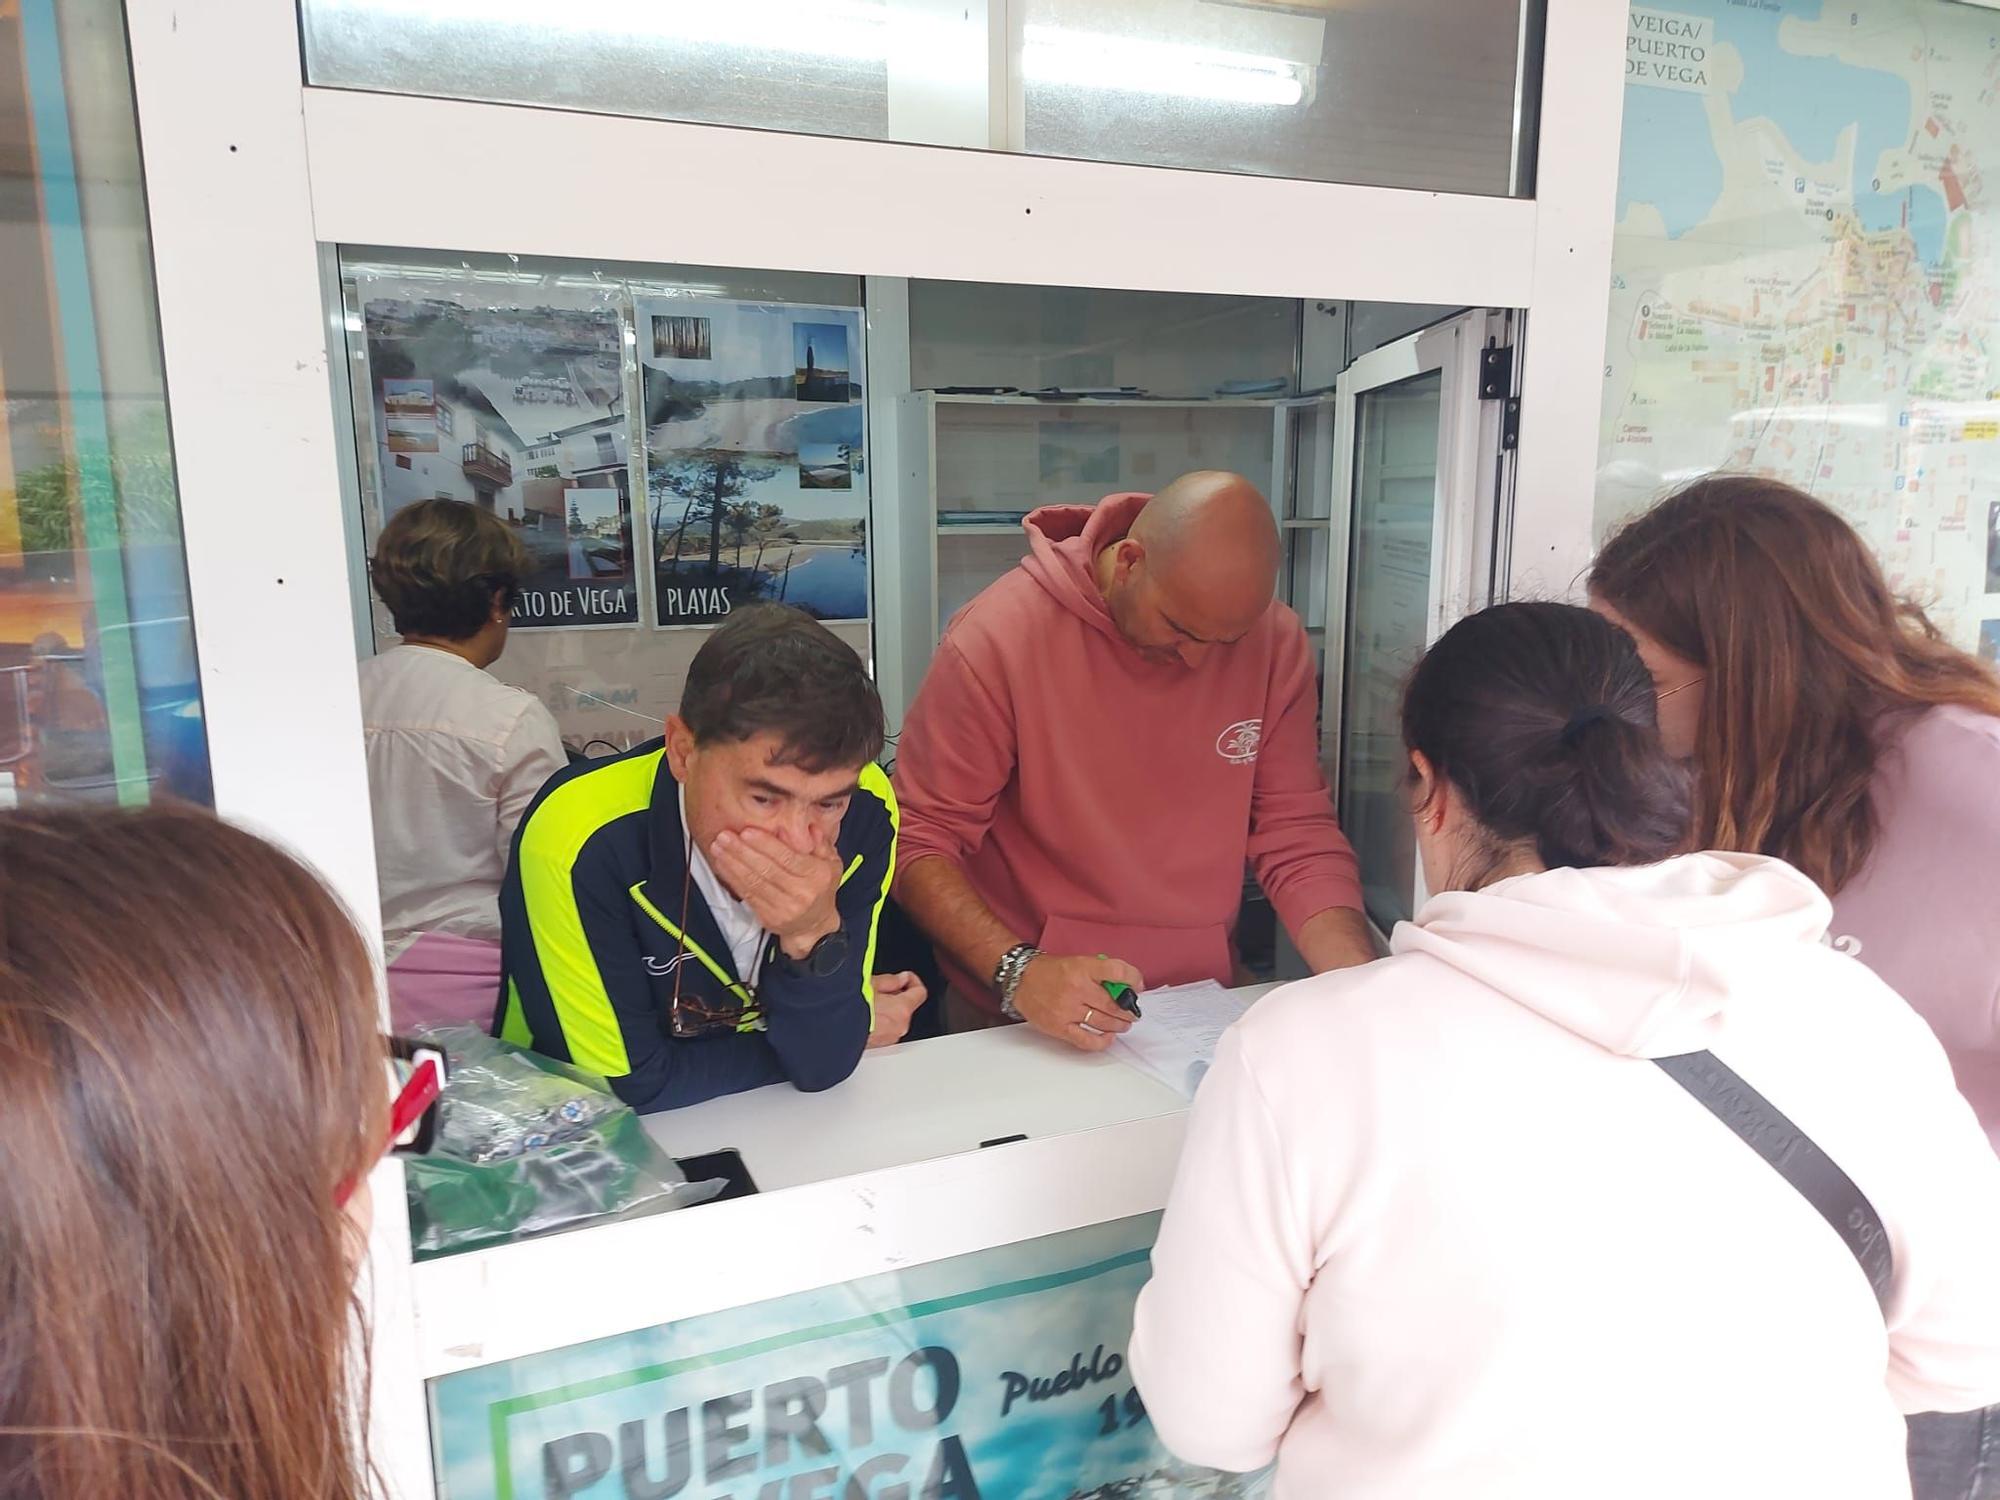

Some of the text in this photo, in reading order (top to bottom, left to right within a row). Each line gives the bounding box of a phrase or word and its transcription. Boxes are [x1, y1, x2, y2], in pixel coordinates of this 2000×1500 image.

[1631, 13, 1702, 40] VEIGA/
[1626, 36, 1705, 62] PUERTO
[1625, 59, 1708, 86] DE VEGA
[550, 591, 573, 617] DE
[667, 587, 731, 616] PLAYAS
[1000, 1344, 1122, 1418] Pueblo
[542, 1346, 960, 1500] PUERTO
